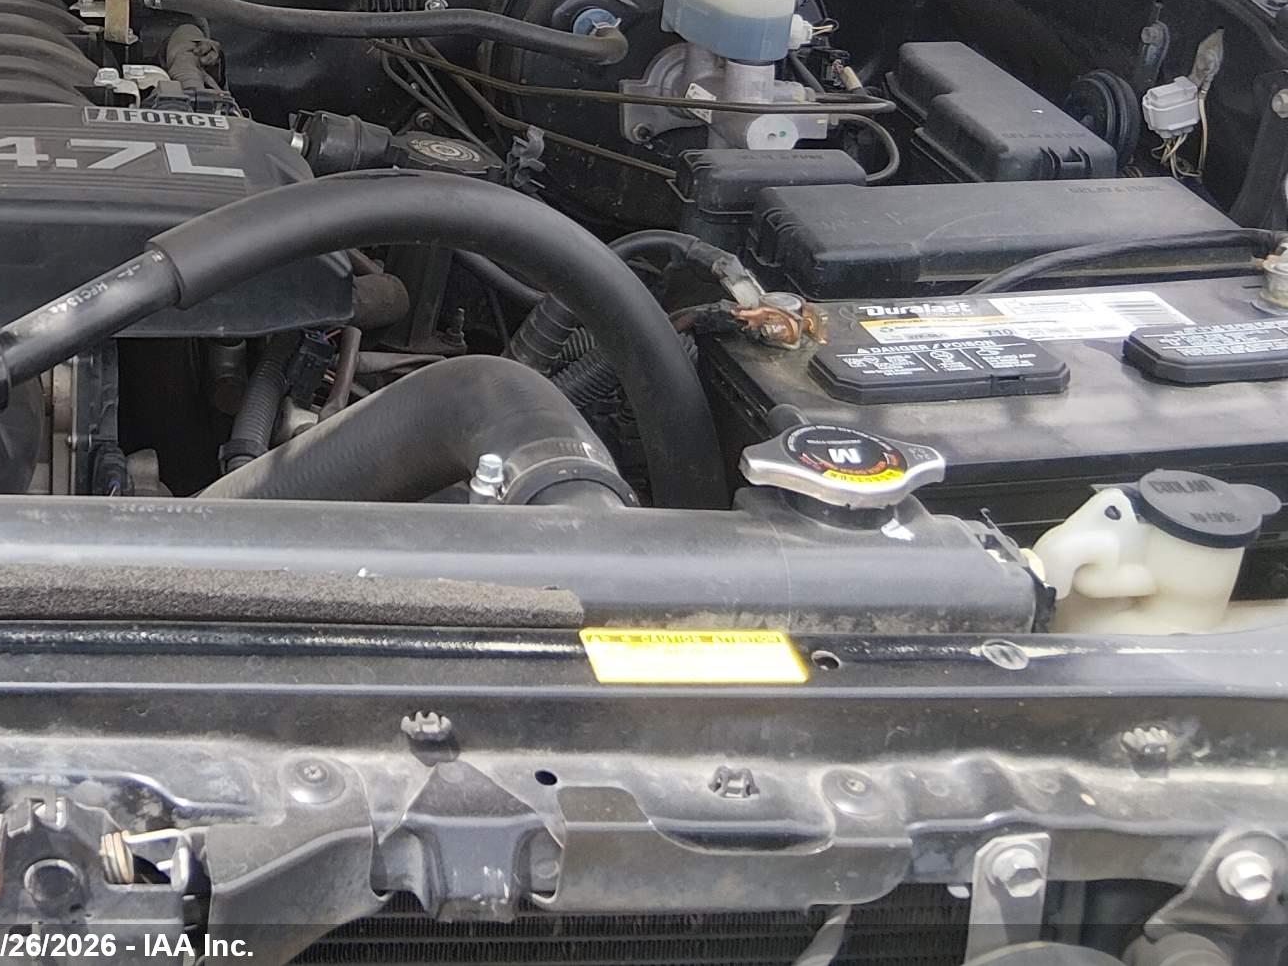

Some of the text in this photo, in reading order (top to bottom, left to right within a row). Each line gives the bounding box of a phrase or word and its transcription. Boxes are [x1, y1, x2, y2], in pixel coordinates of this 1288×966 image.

[858, 302, 972, 317] Duralast
[869, 344, 929, 354] DANGER
[943, 339, 997, 349] POISON
